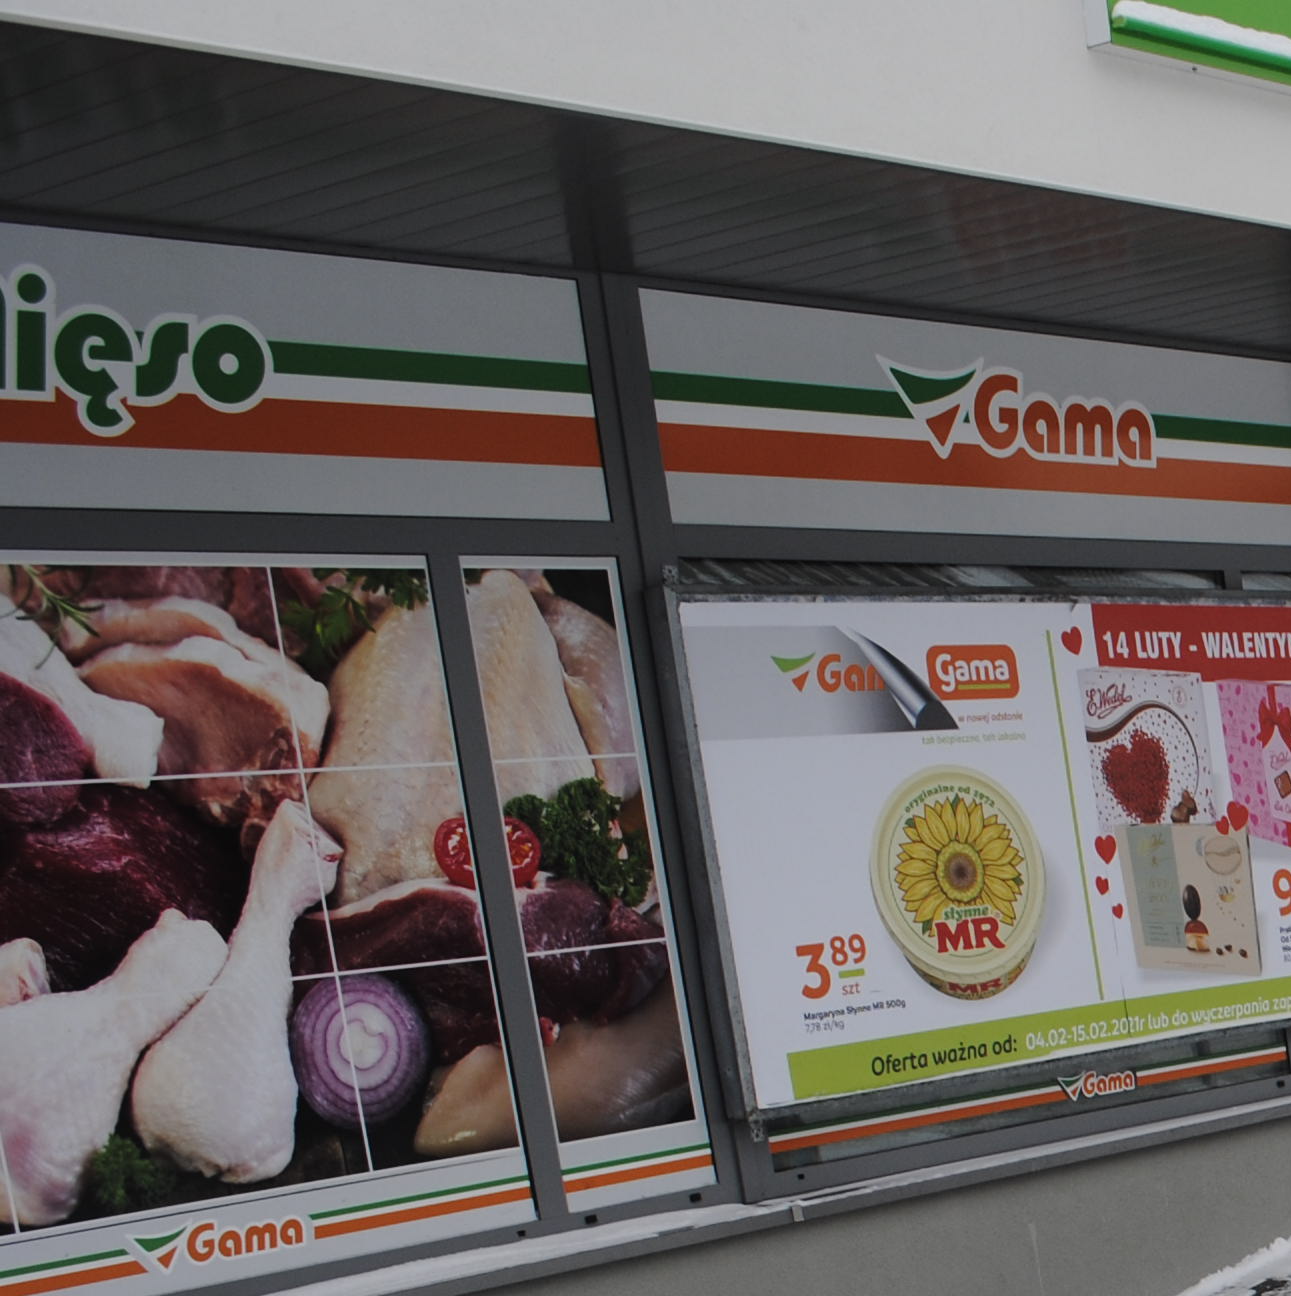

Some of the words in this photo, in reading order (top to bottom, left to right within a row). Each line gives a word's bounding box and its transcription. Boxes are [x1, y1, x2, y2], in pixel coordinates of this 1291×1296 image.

[0, 271, 267, 428] ięso
[974, 374, 1152, 462] Gama
[1102, 631, 1129, 659] 14
[1135, 631, 1183, 659] LUTY
[944, 905, 989, 922] słynne
[935, 917, 1006, 953] MR
[841, 982, 861, 996] szt
[947, 978, 1003, 994] MR
[804, 1008, 846, 1021] Margaryna
[871, 1052, 928, 1077] Oferta
[932, 1041, 988, 1066] ważna
[991, 1034, 1018, 1056] od:
[1147, 1013, 1170, 1030] lub
[1172, 1009, 1189, 1025] do
[1191, 994, 1271, 1024] wyczerpania
[1082, 1070, 1135, 1097] Gama
[186, 1217, 305, 1264] Gama
